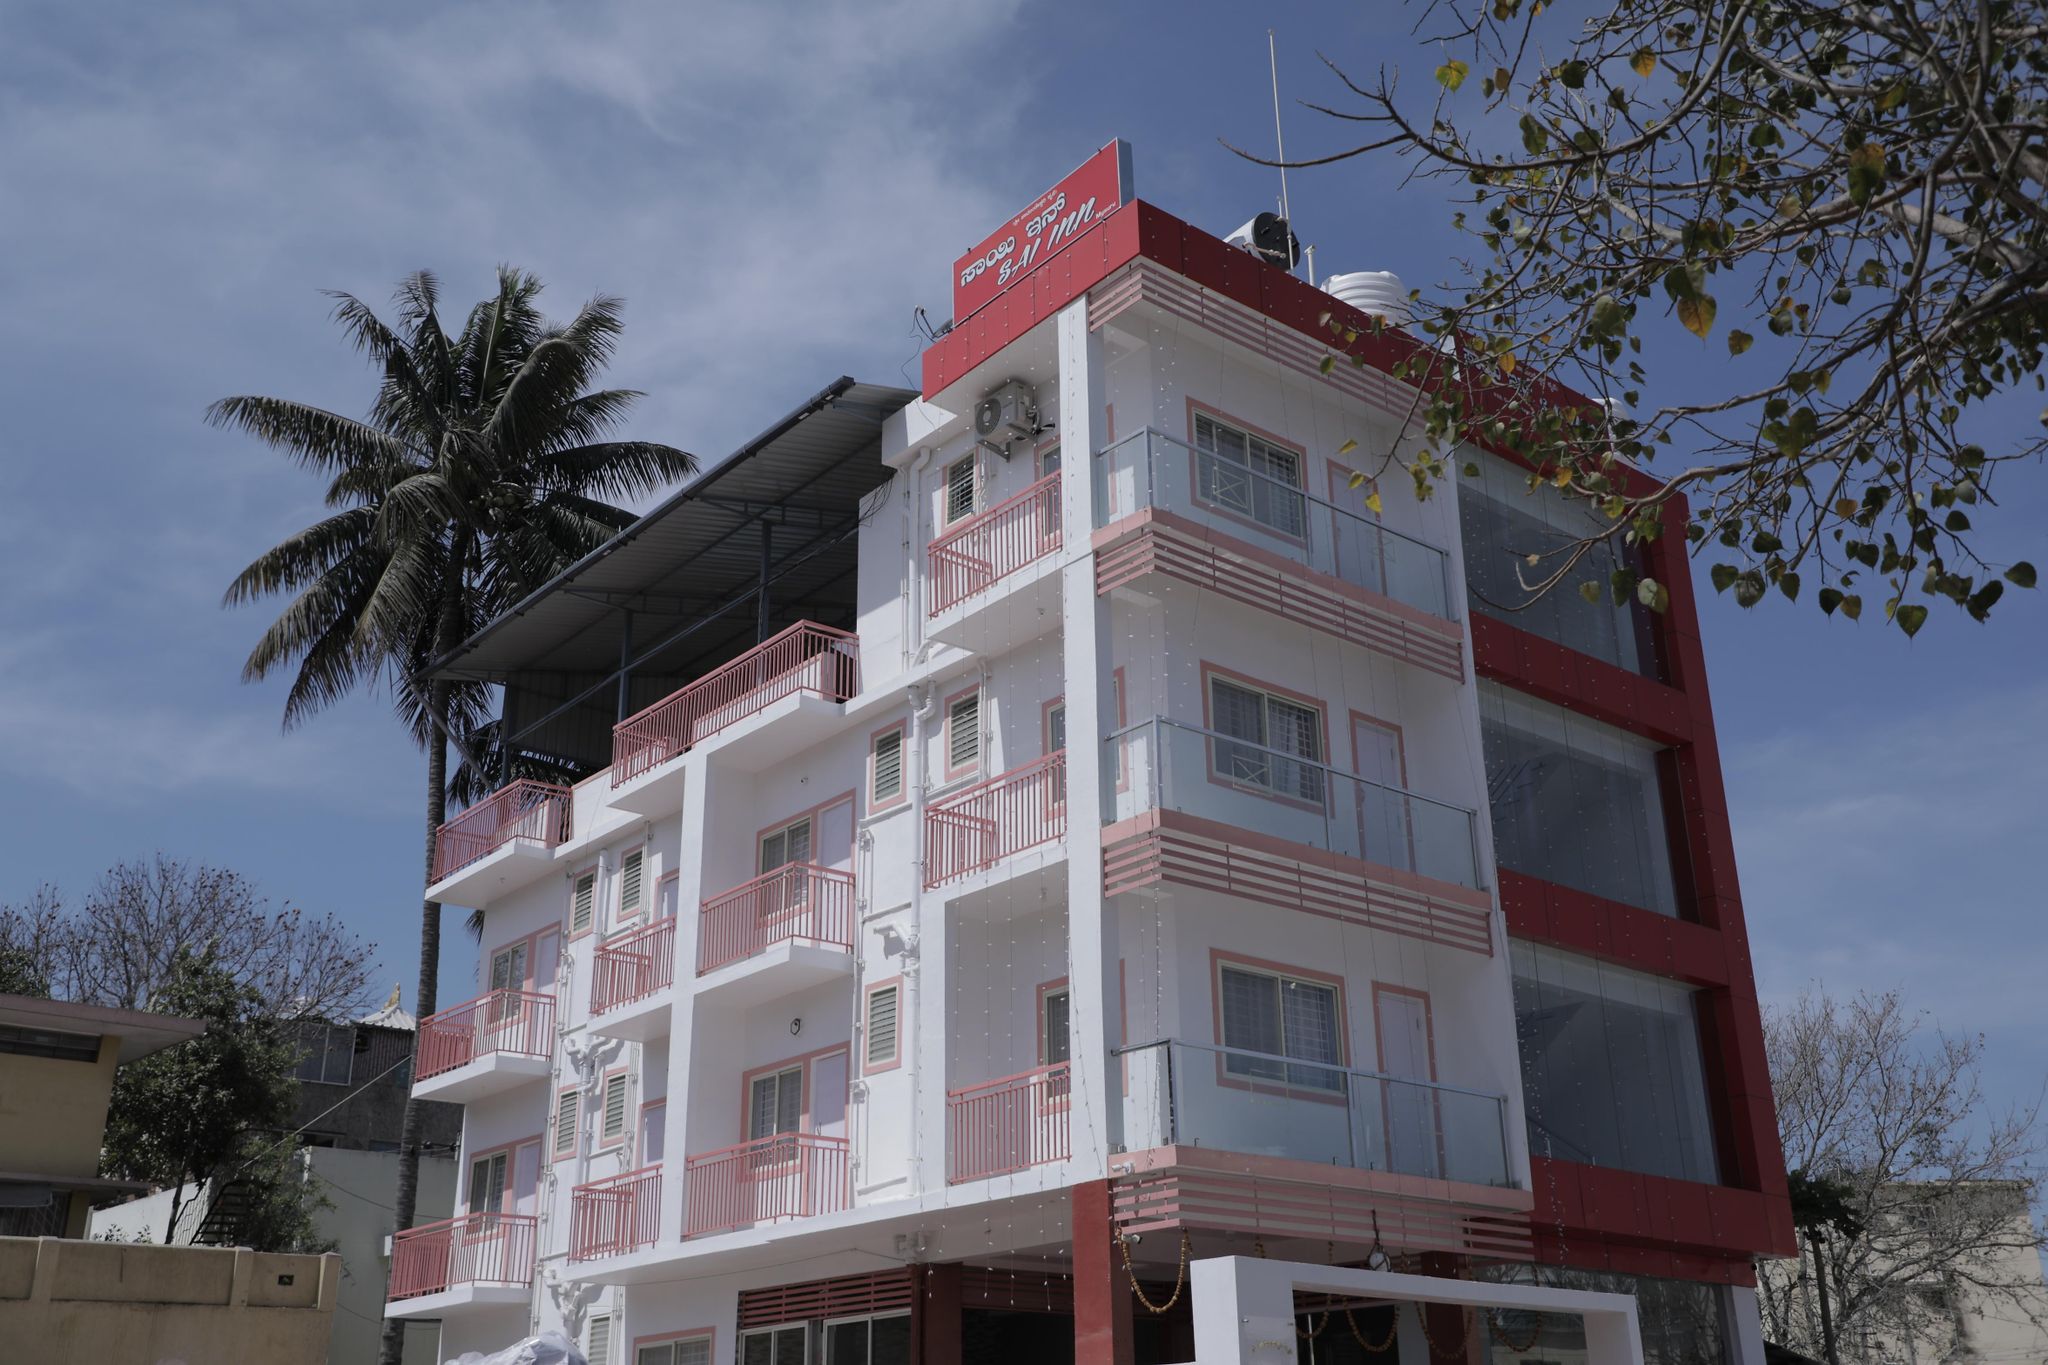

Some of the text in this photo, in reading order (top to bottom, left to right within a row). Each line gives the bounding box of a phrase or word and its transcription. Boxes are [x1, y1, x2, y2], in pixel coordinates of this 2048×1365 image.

[960, 236, 1016, 287] ಸಾಯಿ
[1025, 192, 1066, 238] ಇನ್
[997, 237, 1042, 286] SAI
